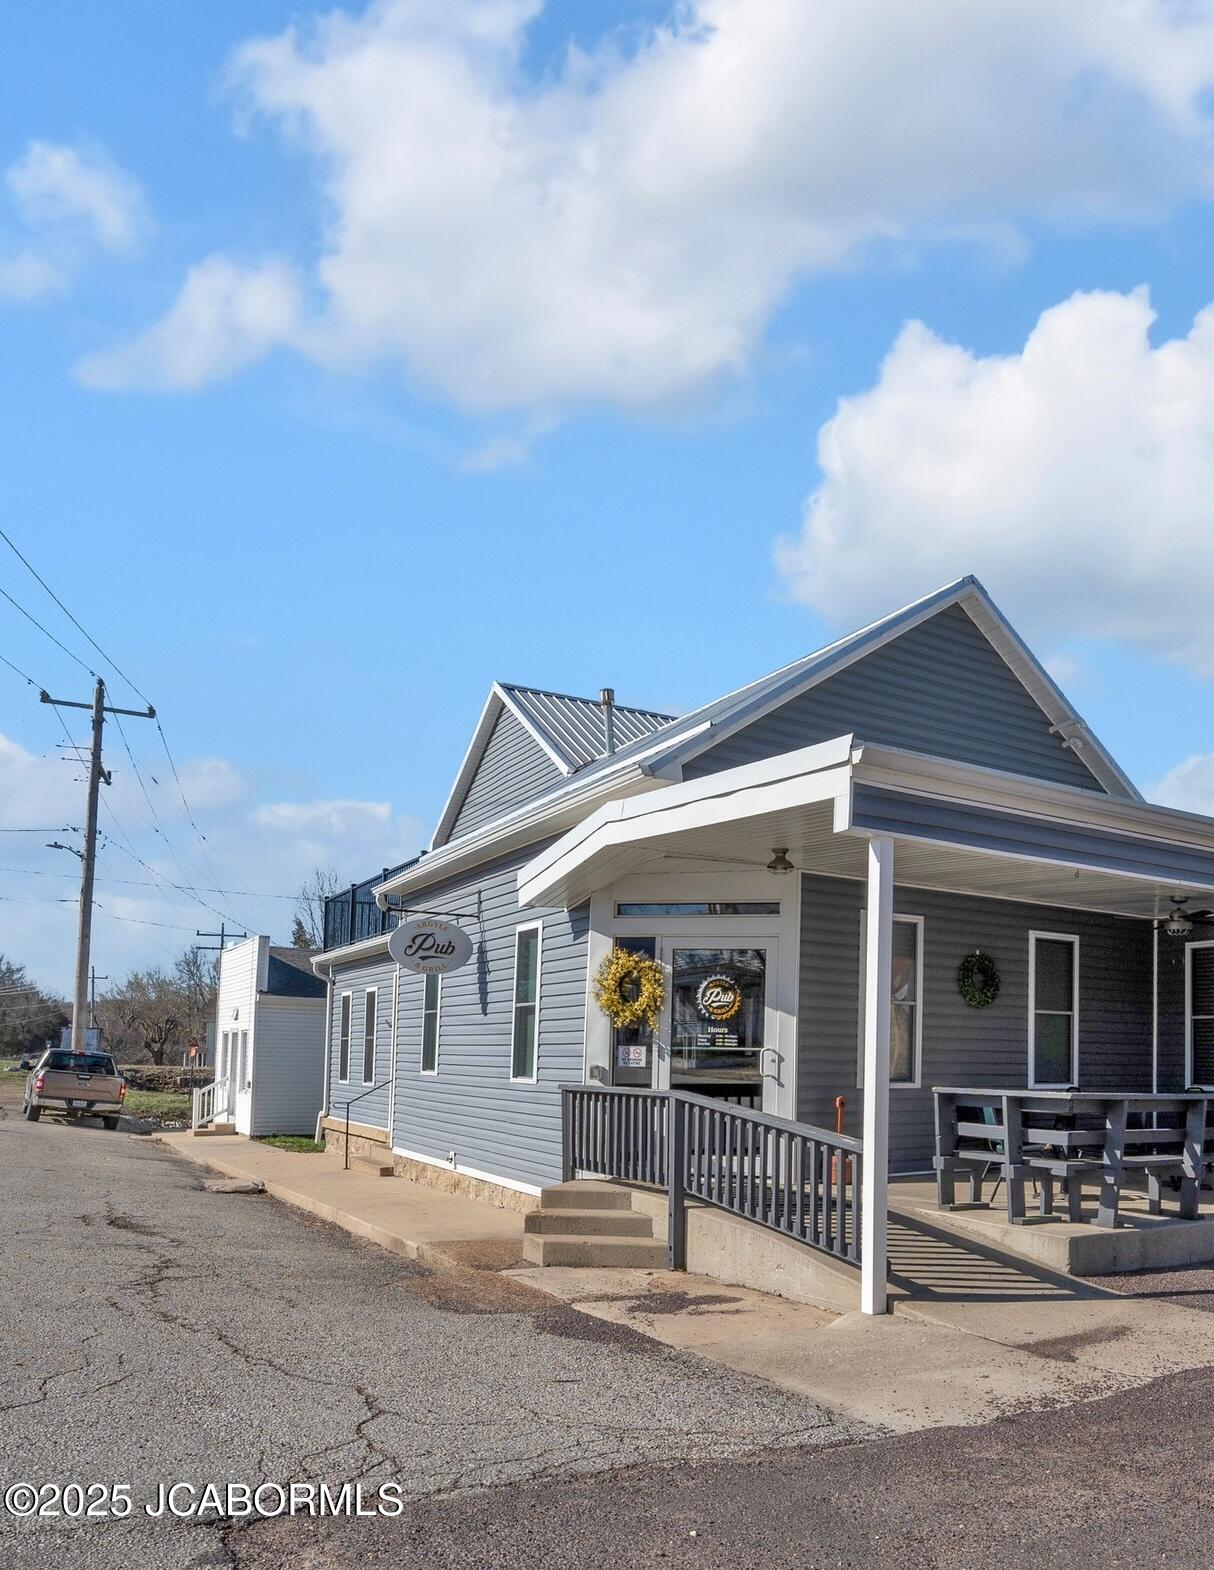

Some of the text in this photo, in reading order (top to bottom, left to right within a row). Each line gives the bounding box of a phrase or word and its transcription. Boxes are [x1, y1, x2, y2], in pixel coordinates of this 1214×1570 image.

[416, 921, 448, 932] ARGYLE
[404, 933, 455, 957] Pub
[422, 963, 449, 973] GRILL
[703, 987, 734, 1005] Pub
